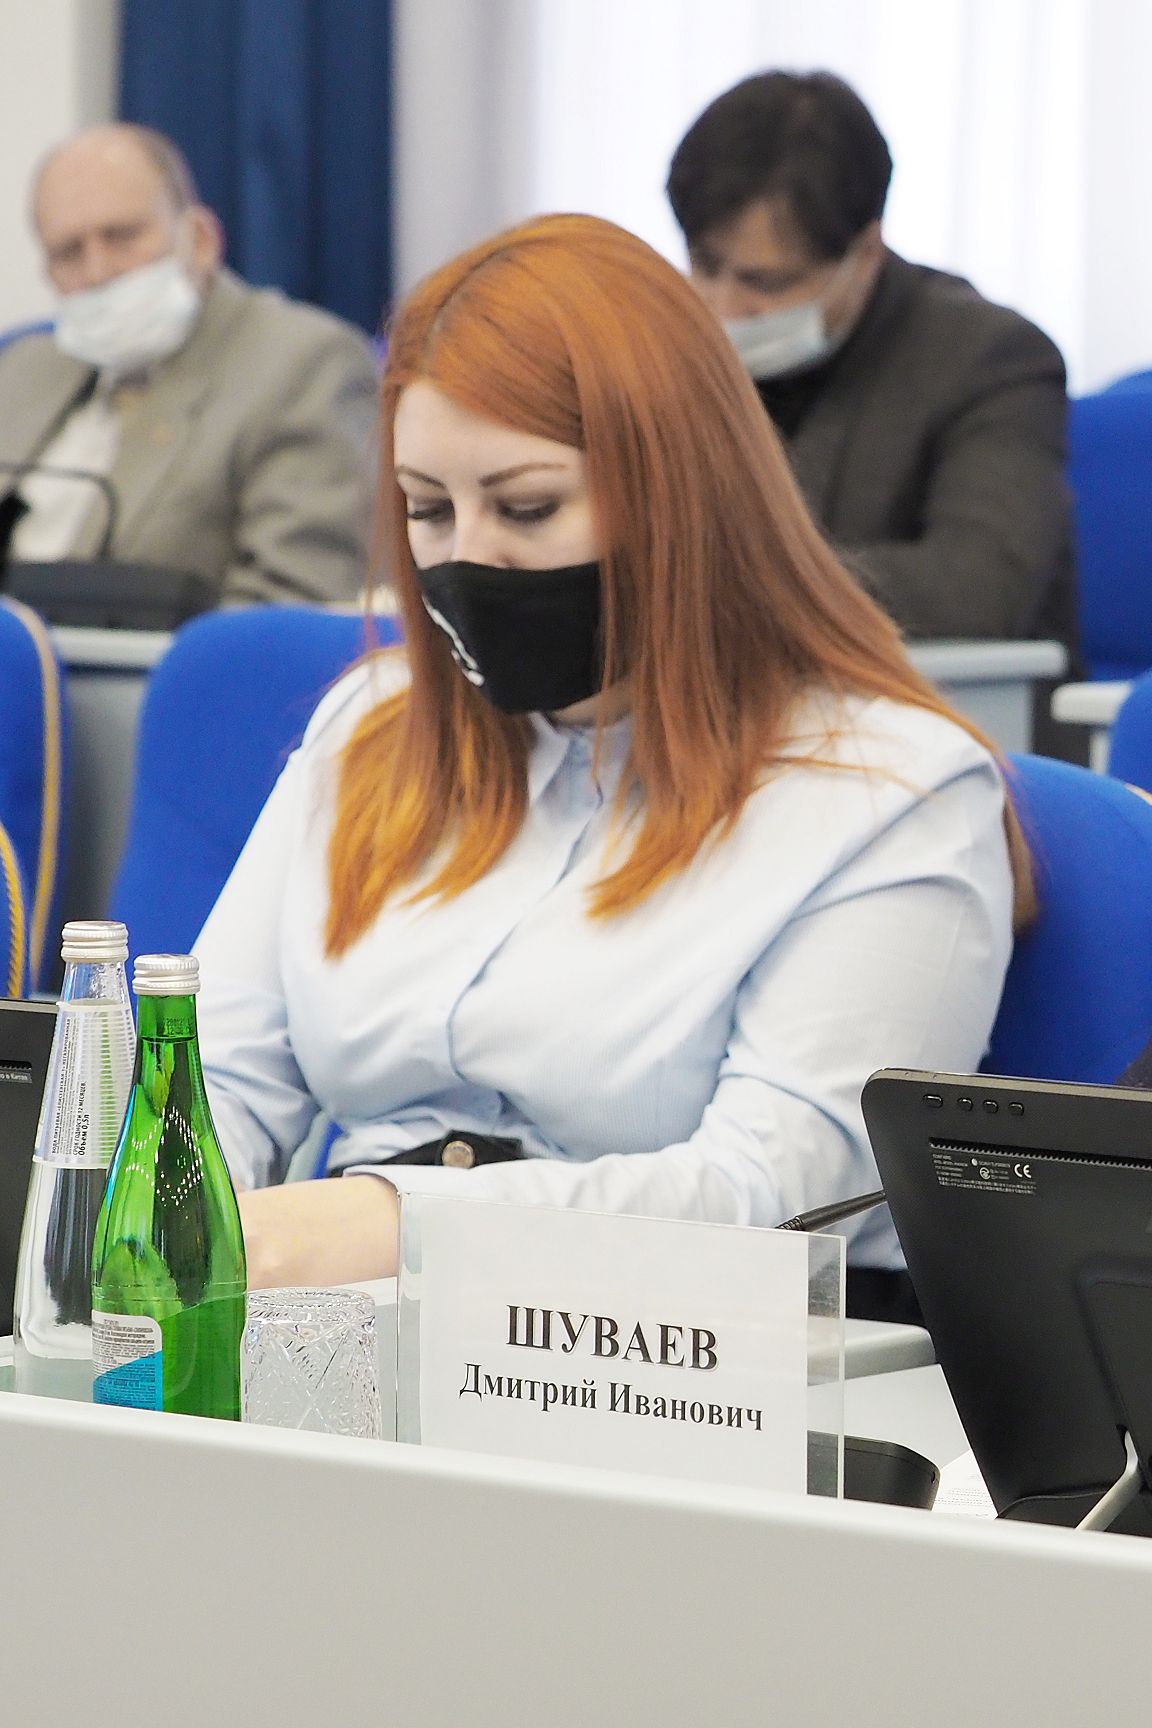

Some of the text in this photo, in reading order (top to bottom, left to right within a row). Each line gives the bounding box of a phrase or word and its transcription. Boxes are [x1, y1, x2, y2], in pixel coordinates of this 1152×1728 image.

[74, 1114, 82, 1141] ГОДНОСТИ
[78, 1114, 90, 1156] Объем 0,5л
[505, 1304, 719, 1371] ШУВАЕВ
[459, 1362, 763, 1431] Дмитрий Иванович
